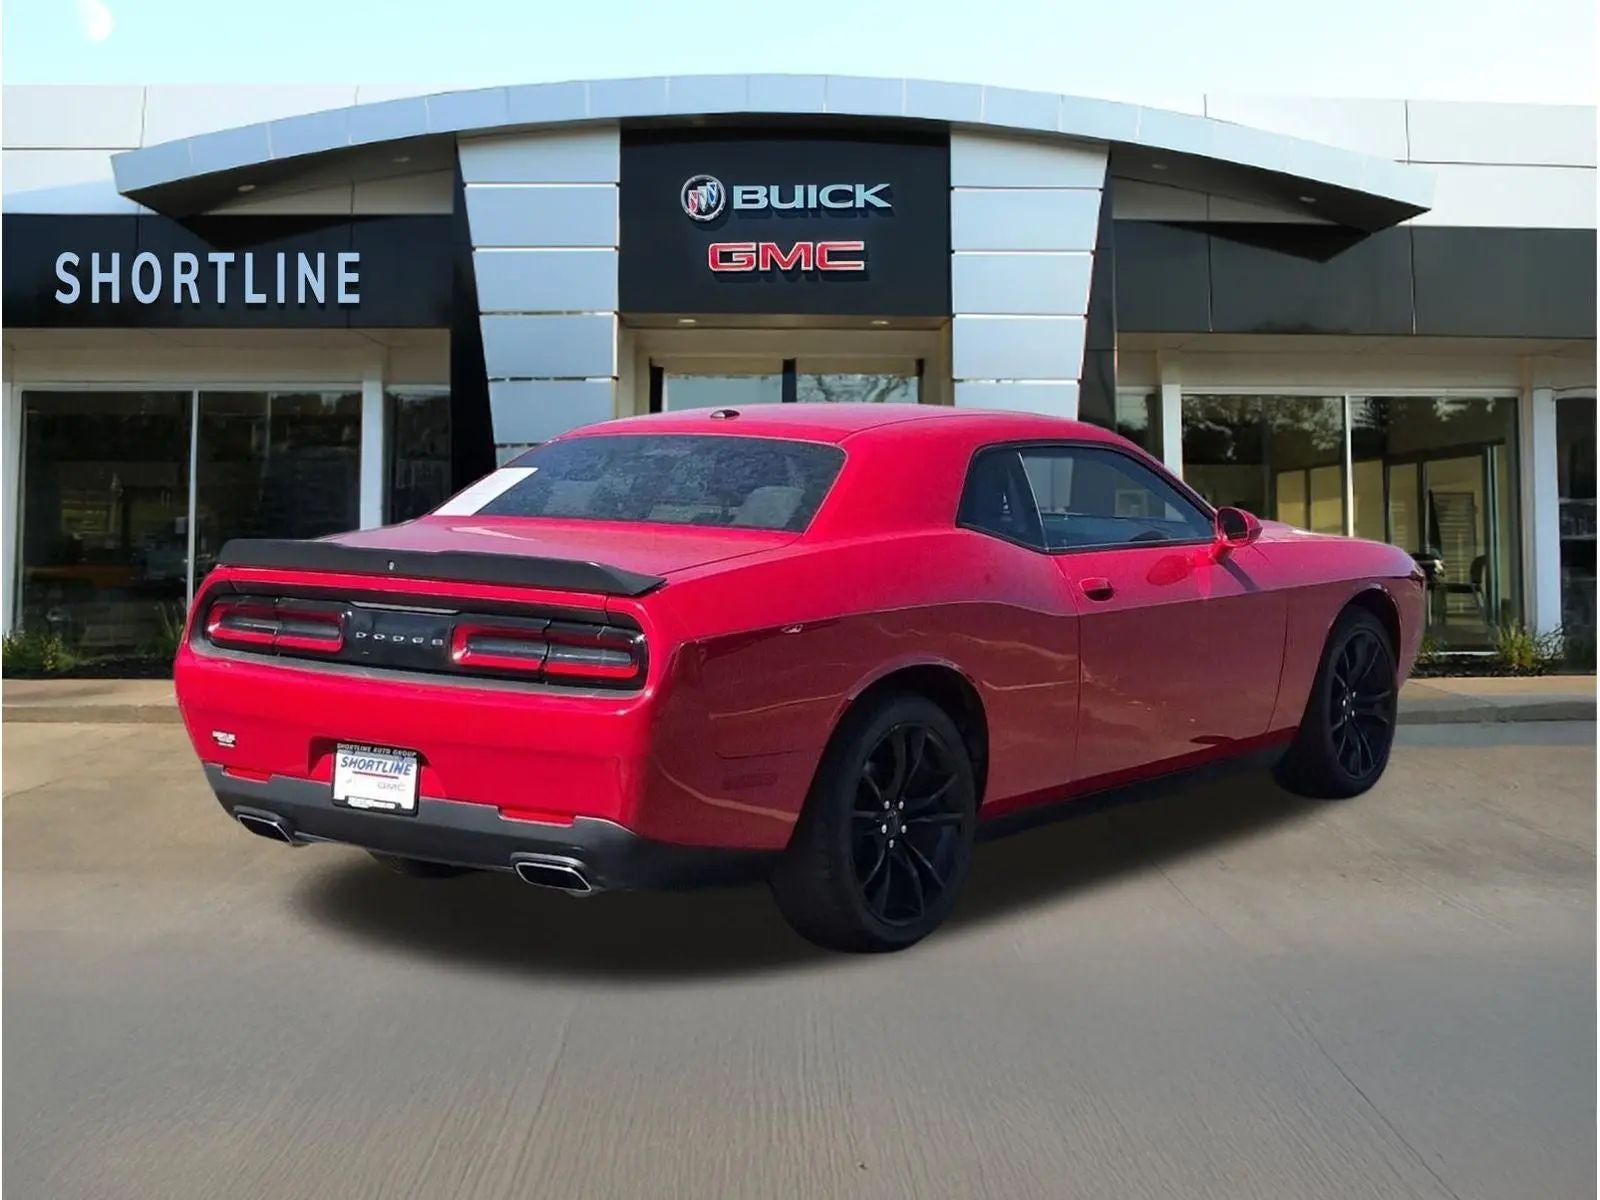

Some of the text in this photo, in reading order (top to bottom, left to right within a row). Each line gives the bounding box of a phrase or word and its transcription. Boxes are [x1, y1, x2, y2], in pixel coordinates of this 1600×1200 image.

[733, 184, 892, 209] BUICK
[708, 241, 864, 272] GMC
[55, 252, 360, 304] SHORTLINE
[355, 631, 443, 645] DODGE
[373, 746, 391, 755] AUTO
[392, 749, 417, 757] GROUP
[341, 756, 413, 776] SHORTLINE
